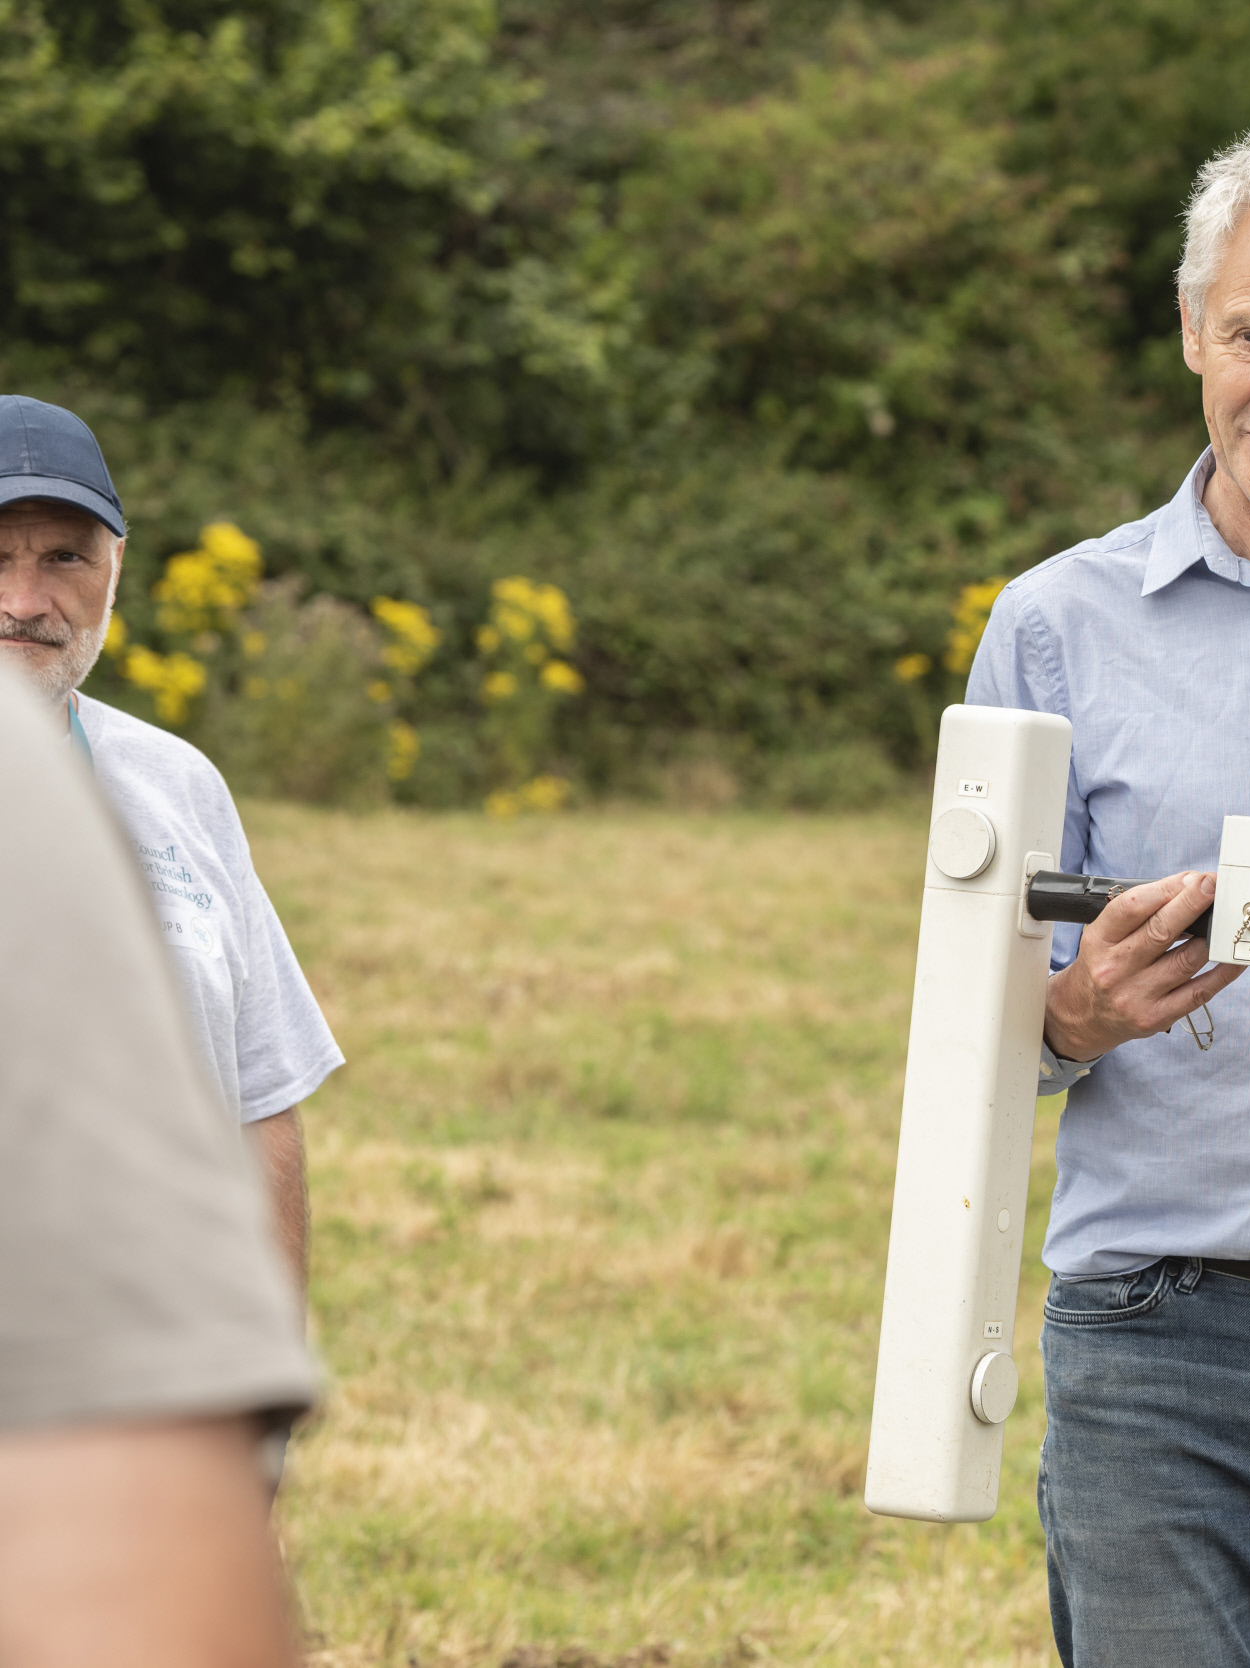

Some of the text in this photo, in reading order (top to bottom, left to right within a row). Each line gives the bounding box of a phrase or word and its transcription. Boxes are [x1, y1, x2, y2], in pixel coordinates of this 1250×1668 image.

[154, 862, 192, 883] British
[150, 878, 213, 910] rchaeology
[176, 922, 182, 933] B
